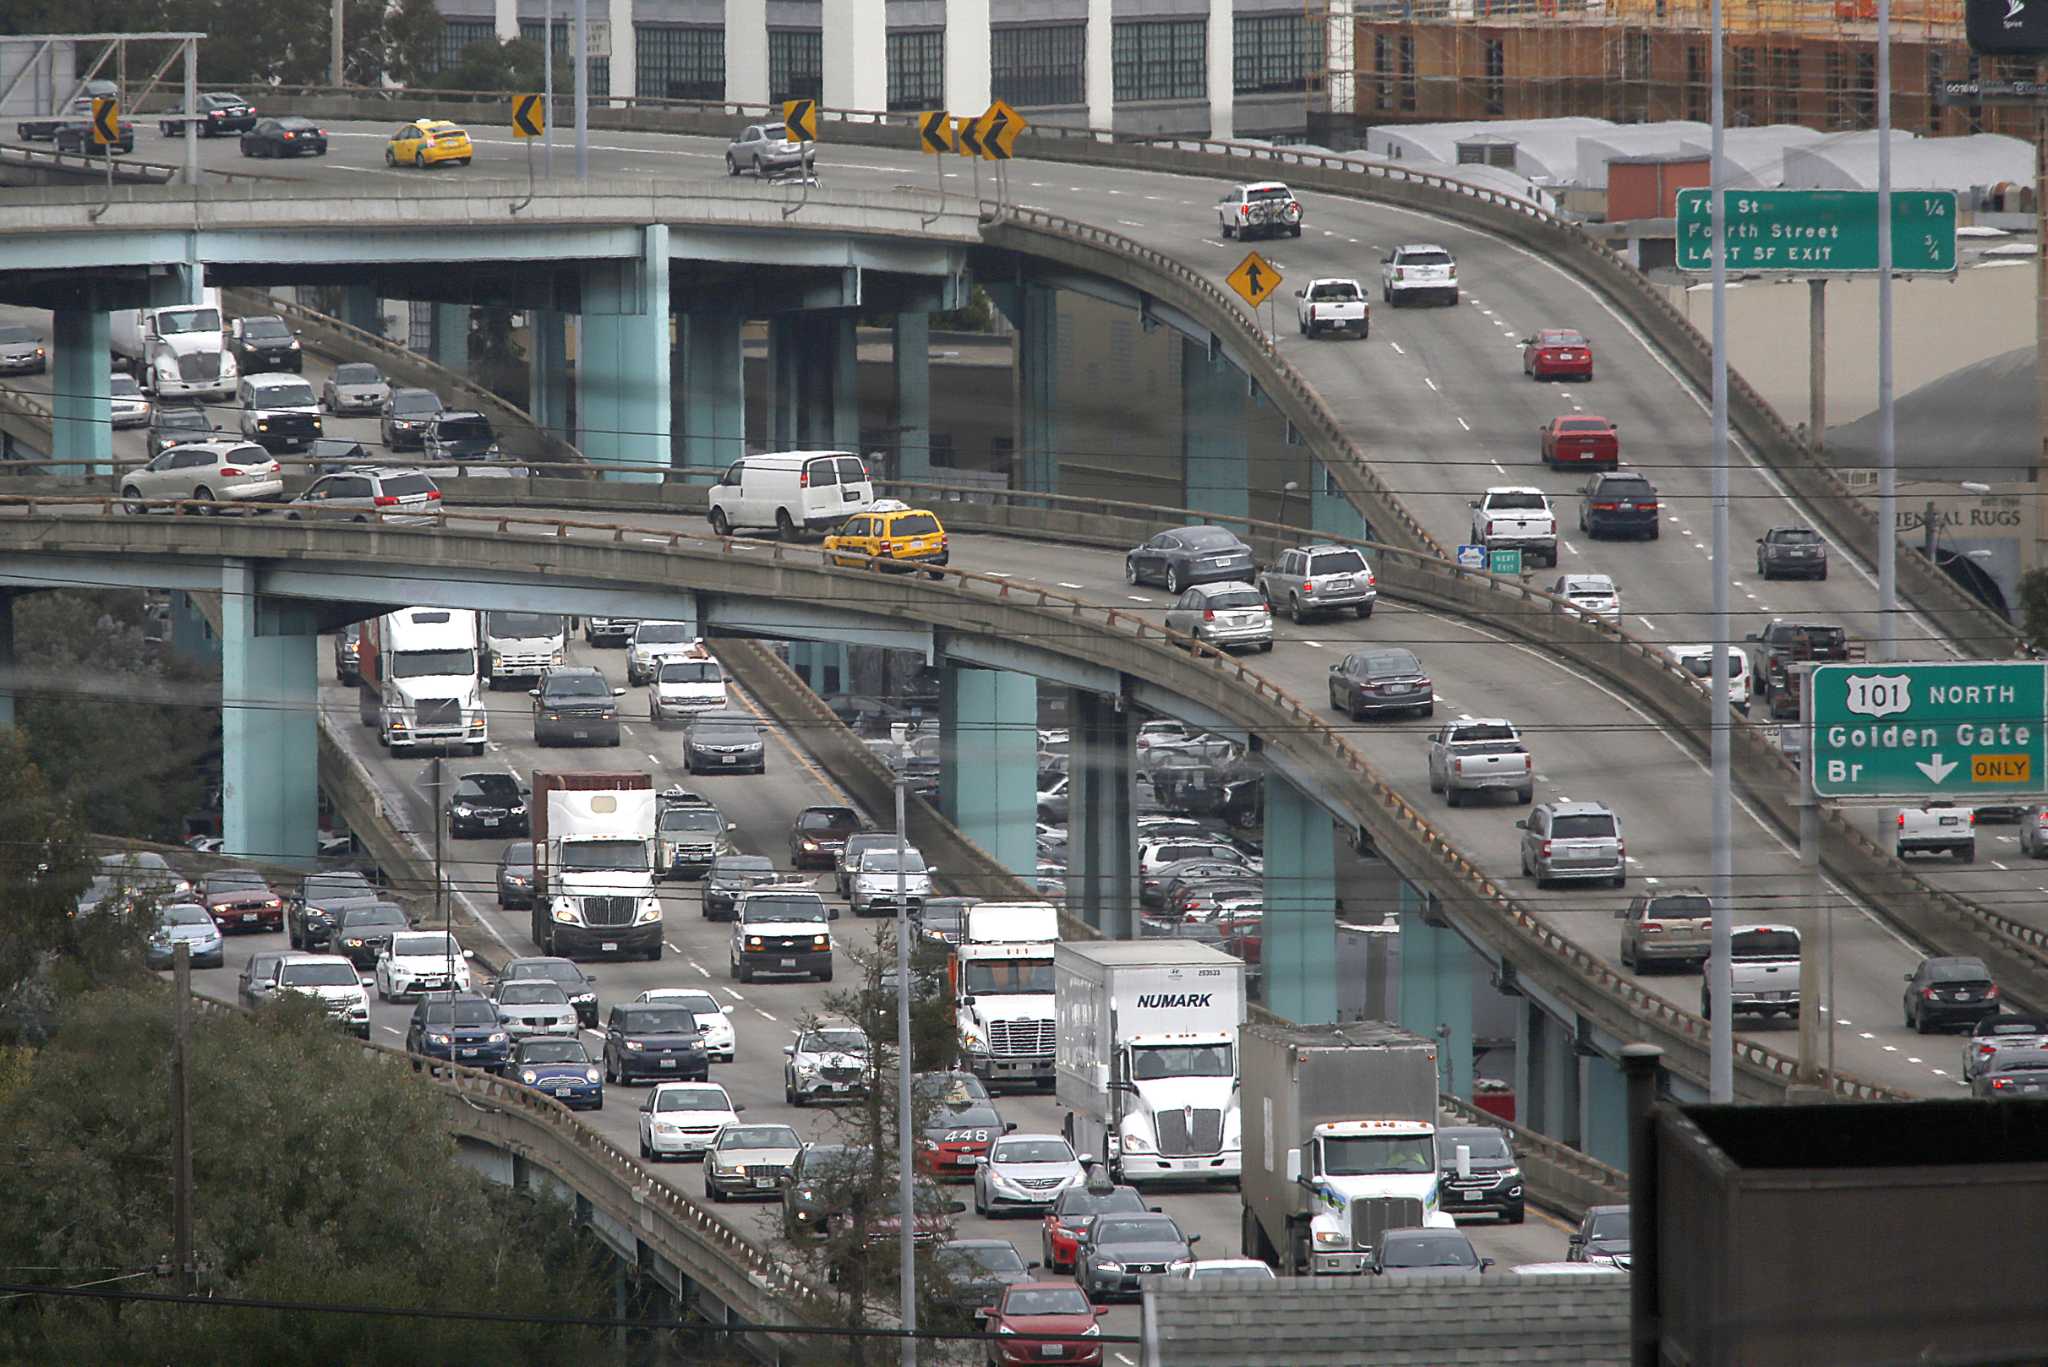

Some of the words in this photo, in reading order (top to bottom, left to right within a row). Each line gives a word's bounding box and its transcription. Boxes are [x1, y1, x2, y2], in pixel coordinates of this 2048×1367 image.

[1691, 199, 1713, 214] 7t
[1738, 199, 1759, 214] St
[1688, 223, 1758, 239] Forth
[1771, 223, 1839, 239] Street
[1688, 247, 1741, 261] LAT
[1753, 247, 1776, 261] SF
[1789, 247, 1833, 261] EXIT
[1970, 509, 2021, 526] RUGS
[1859, 684, 1899, 707] 101
[1930, 686, 2015, 704] NORTH
[1828, 726, 1937, 748] Golden
[1957, 723, 2031, 747] Gate
[1828, 760, 1863, 782] Br
[1975, 761, 2027, 777] ONLY
[1137, 993, 1213, 1008] NUMARK
[945, 1129, 988, 1142] 448
